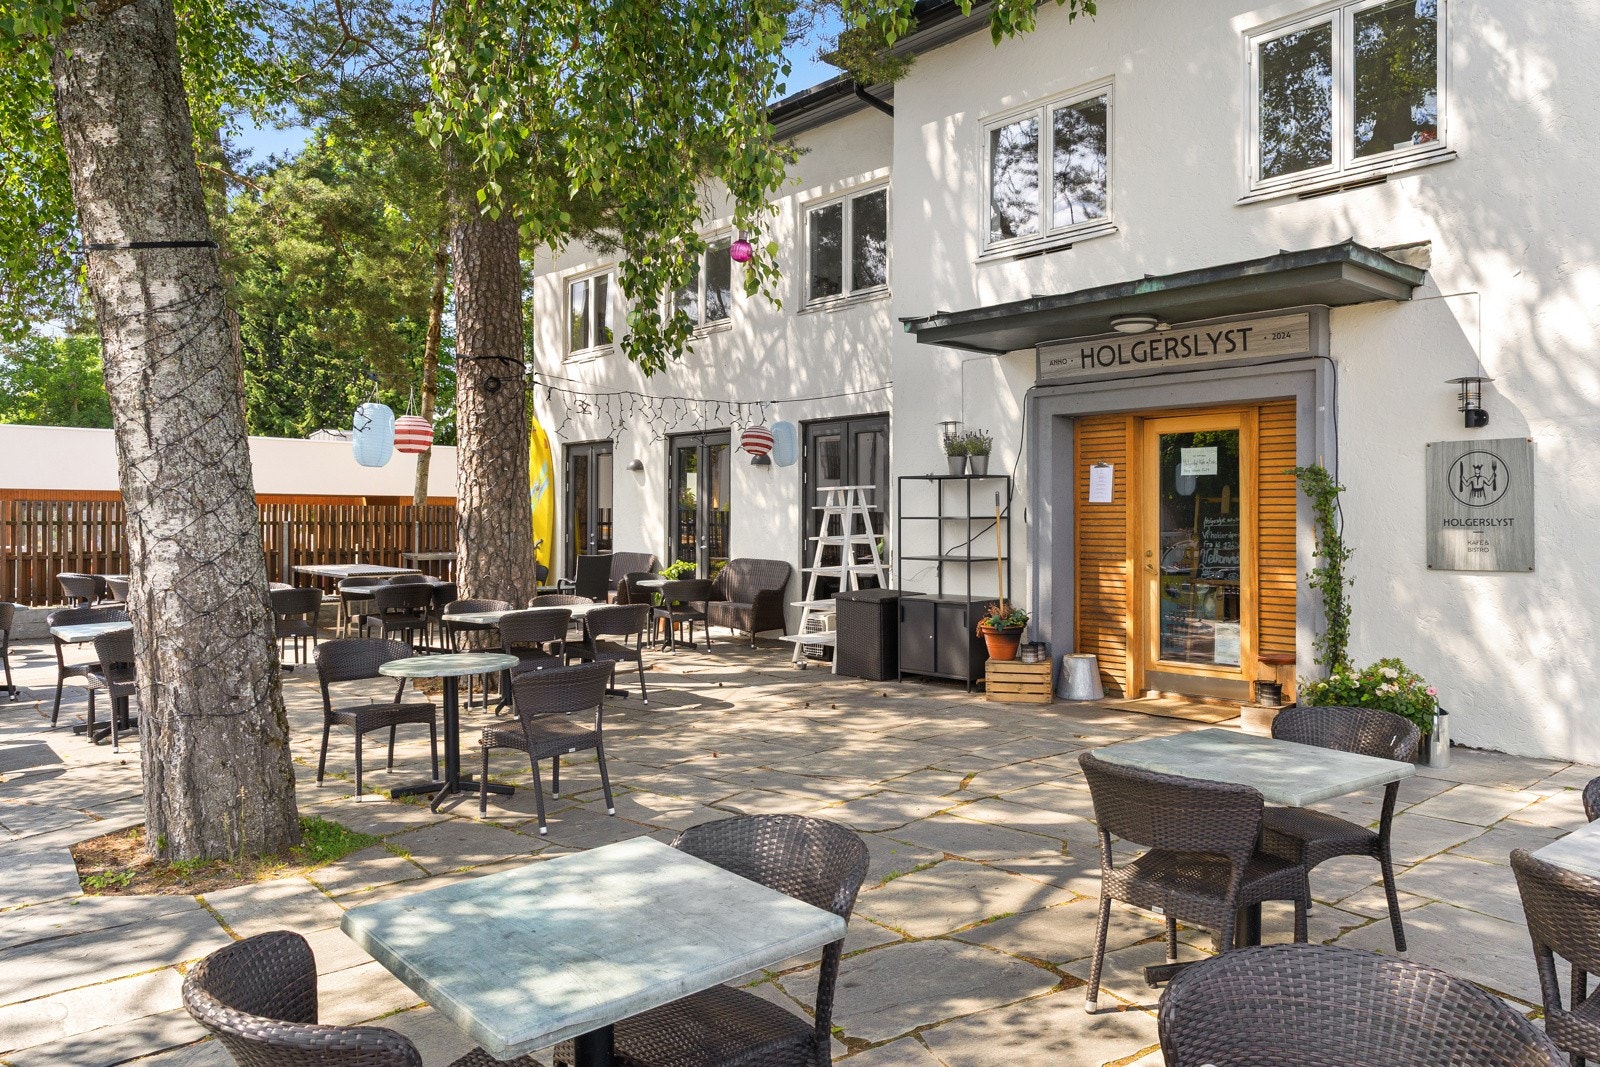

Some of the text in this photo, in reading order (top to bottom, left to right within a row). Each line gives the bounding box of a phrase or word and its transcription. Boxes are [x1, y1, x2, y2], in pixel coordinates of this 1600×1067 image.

[1049, 327, 1291, 369] ANNO HOLGERSLYST 2024
[1443, 518, 1514, 527] HOLGERSLYST
